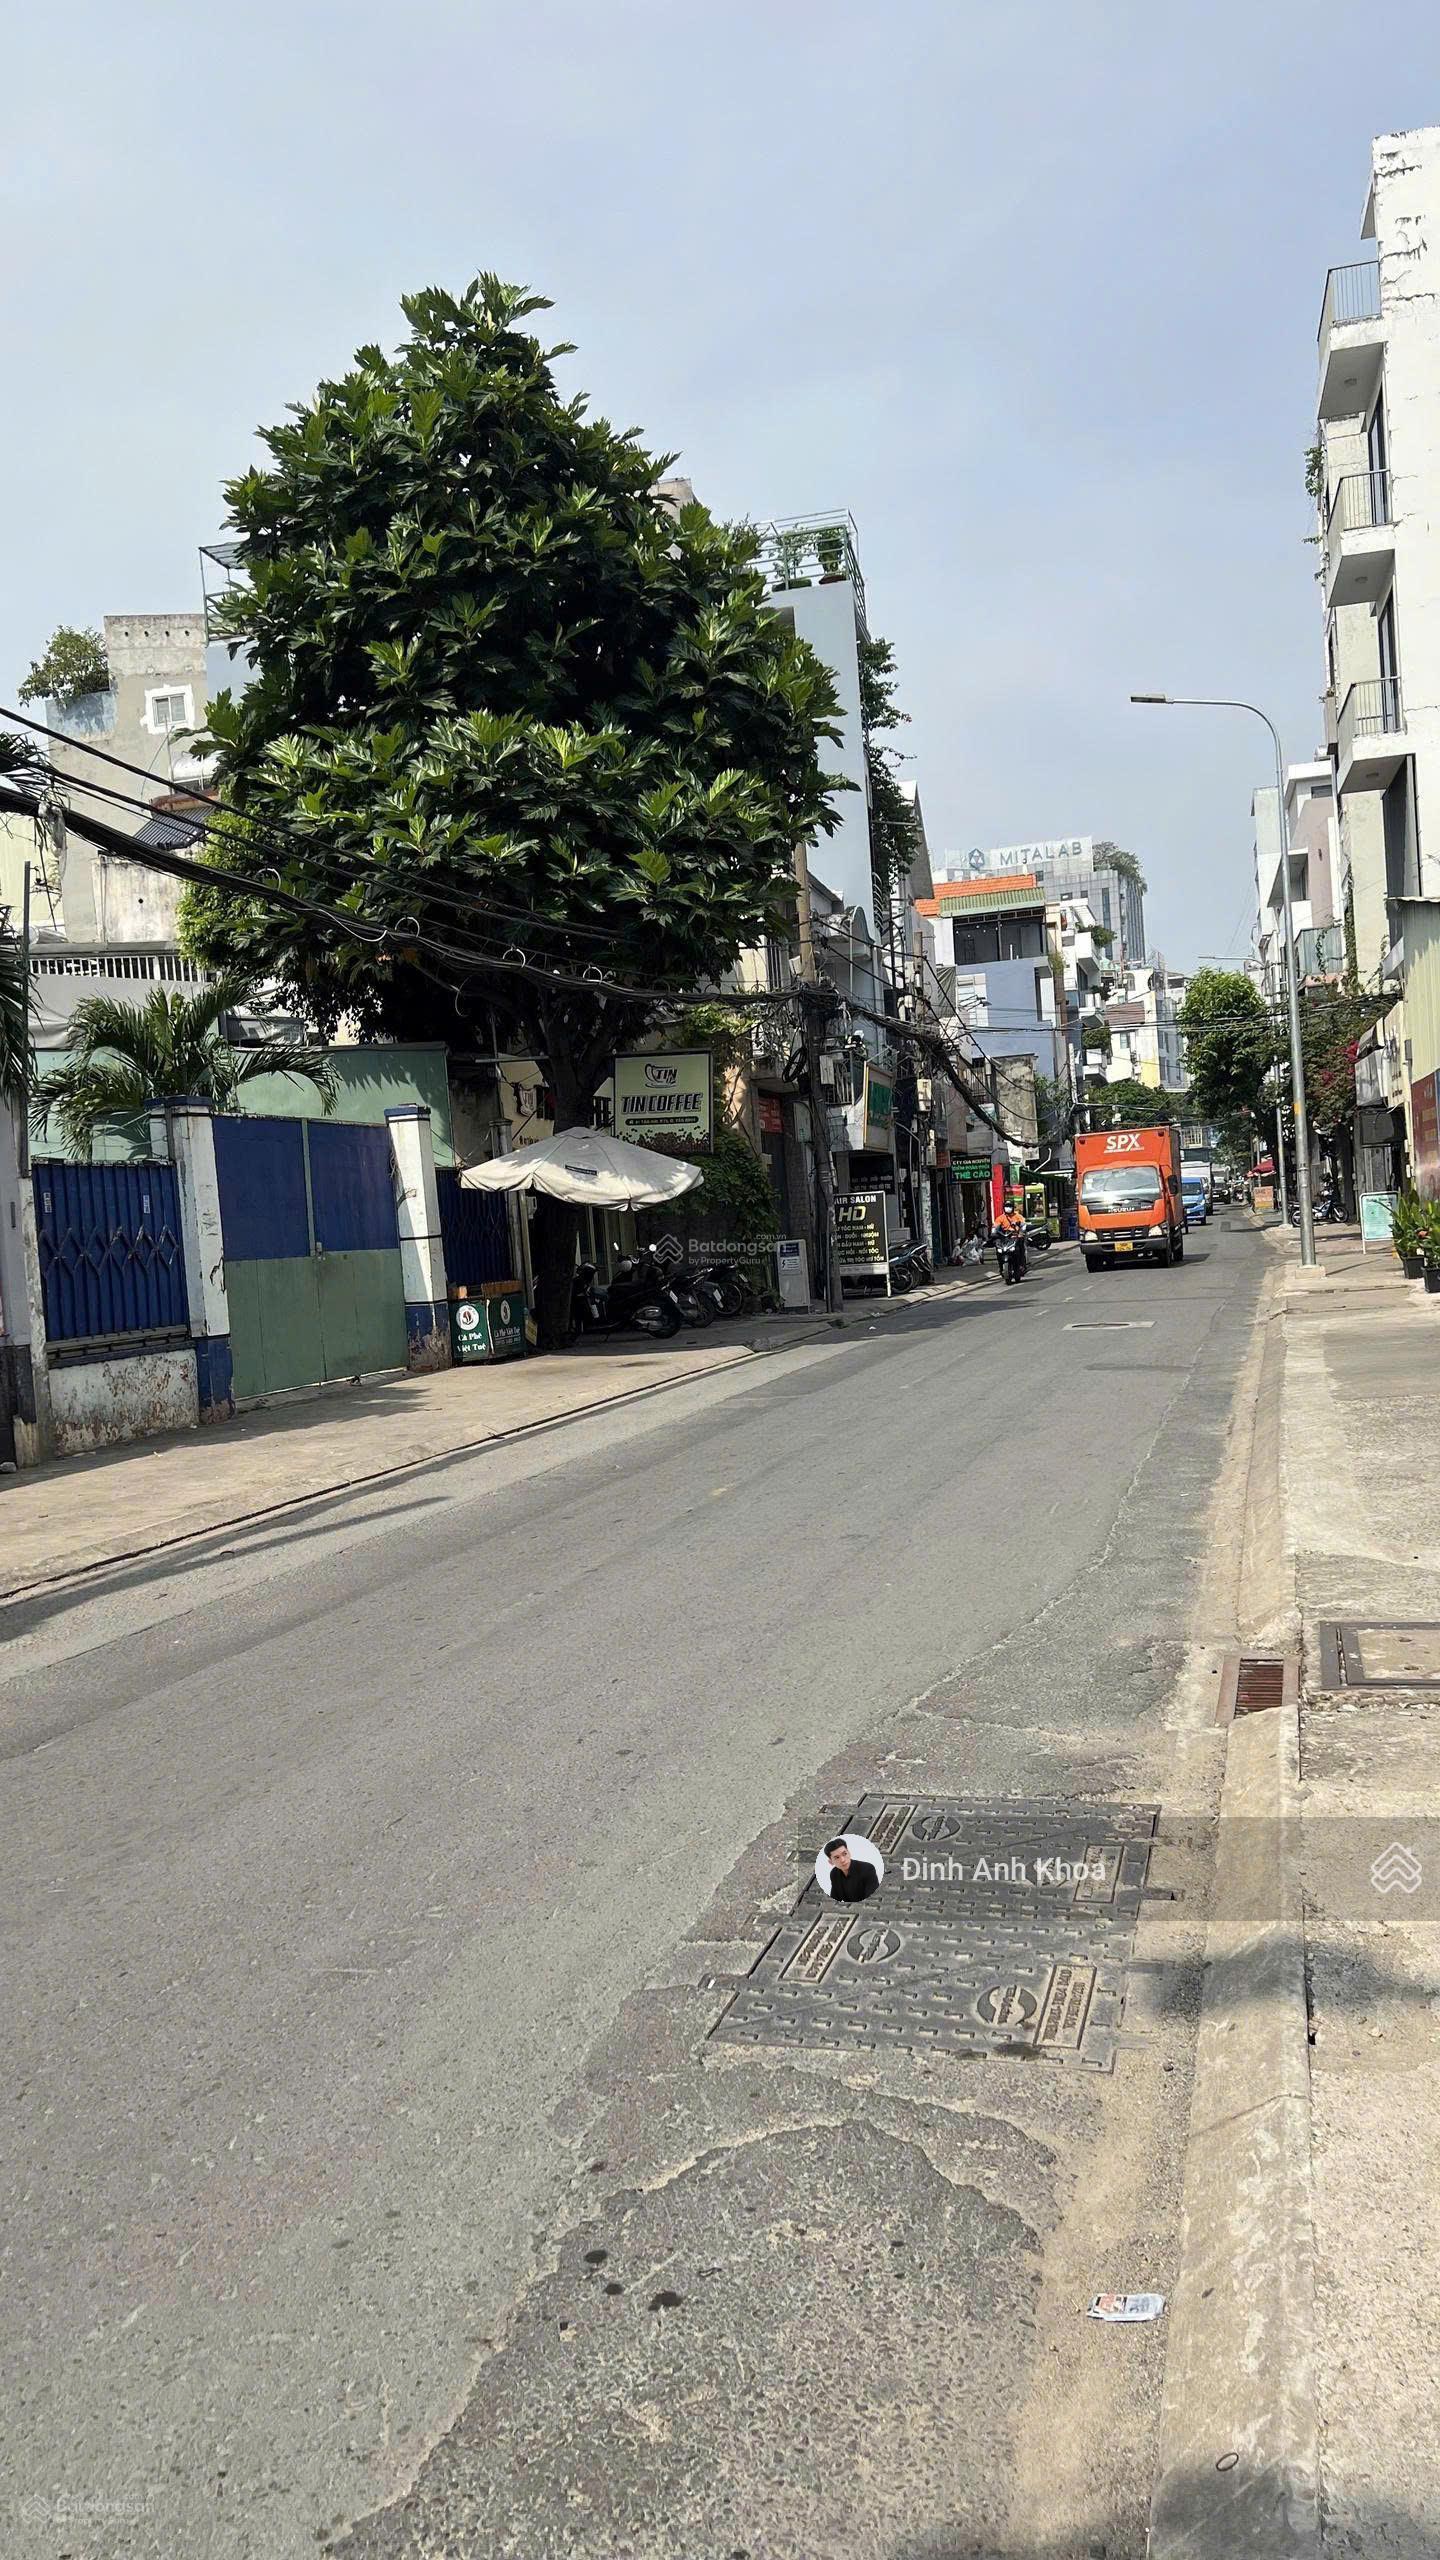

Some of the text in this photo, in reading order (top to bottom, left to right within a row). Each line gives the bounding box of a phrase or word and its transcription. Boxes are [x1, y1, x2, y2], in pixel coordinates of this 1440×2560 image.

[1000, 841, 1082, 866] MITALAB
[656, 1068, 678, 1082] TIN
[622, 1093, 703, 1114] TIN COFFEE
[1106, 1133, 1141, 1152] SPX
[834, 1195, 877, 1205] AIR SALON
[839, 1205, 867, 1222] HD
